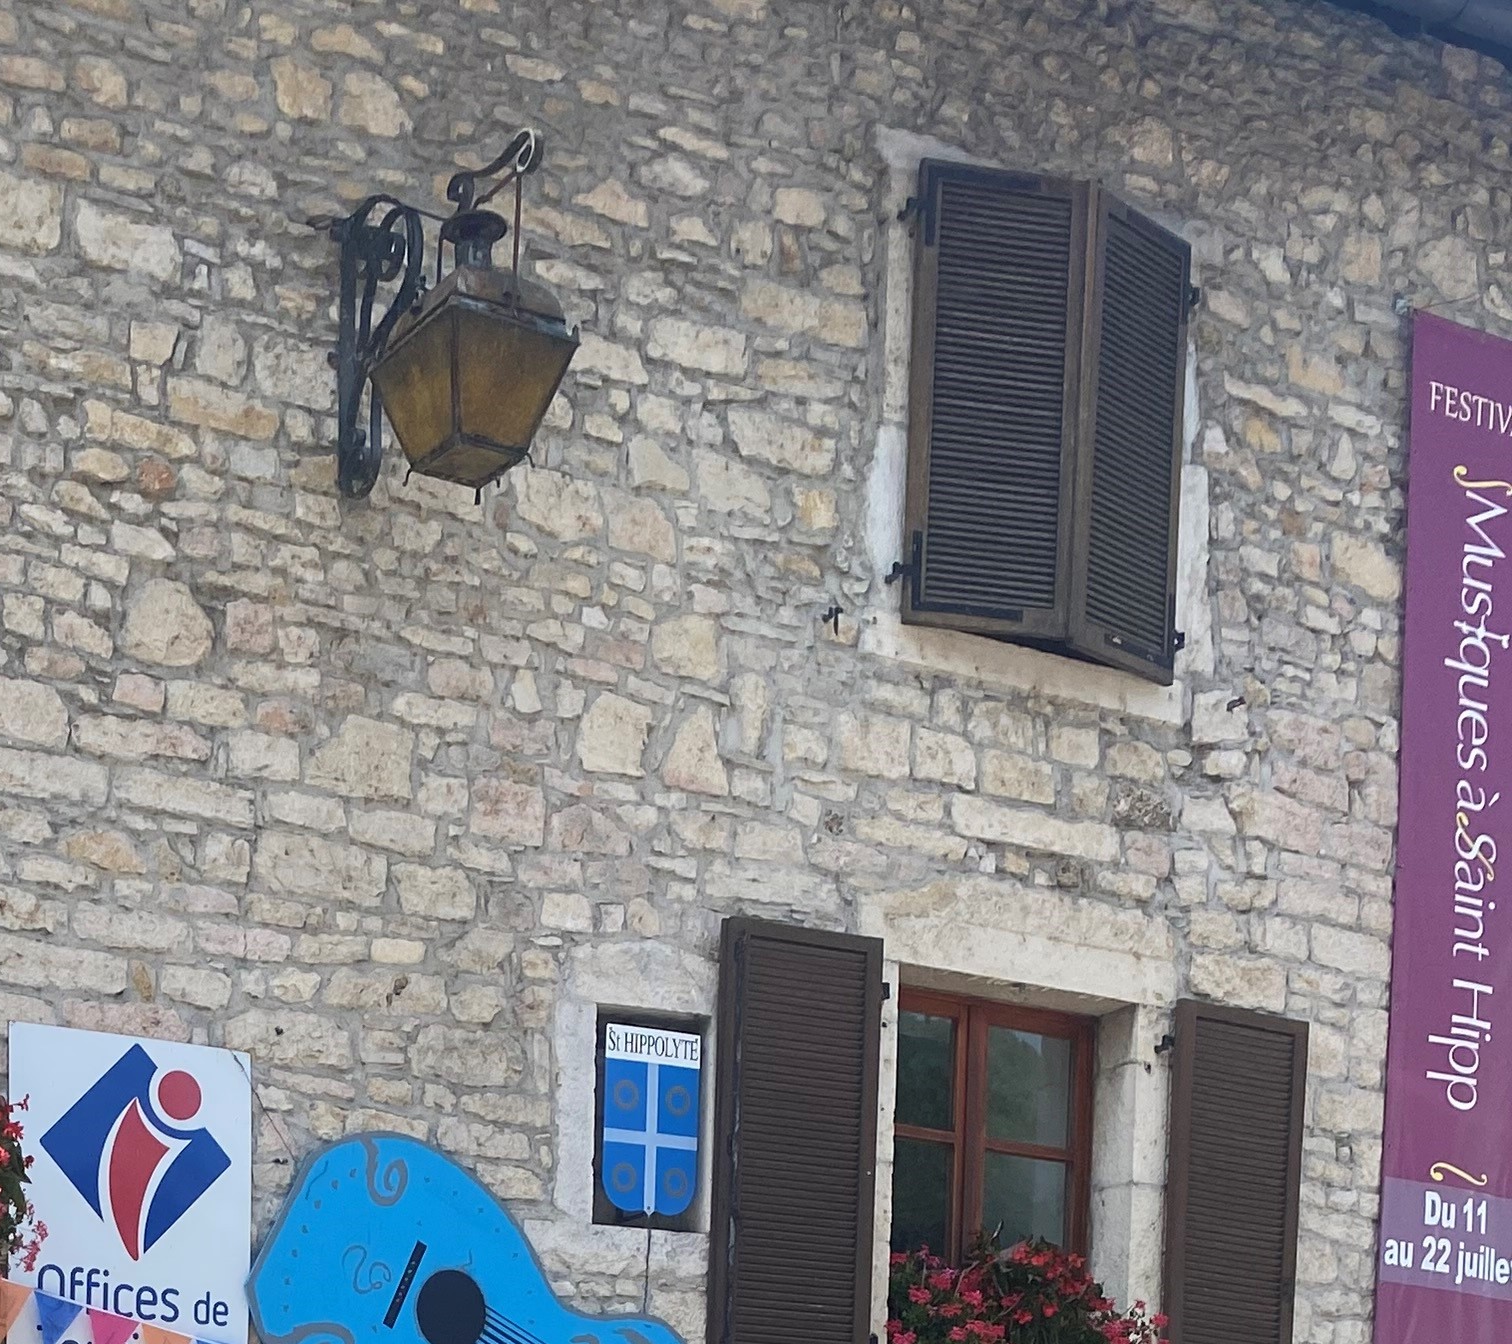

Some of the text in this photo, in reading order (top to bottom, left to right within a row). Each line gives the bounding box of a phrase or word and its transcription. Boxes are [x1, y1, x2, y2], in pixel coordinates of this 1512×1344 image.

[1429, 380, 1512, 437] FESTIV
[1426, 978, 1494, 1111] Hipp
[1424, 1190, 1488, 1235] Du 11
[1384, 1235, 1512, 1285] au 22 juille
[37, 1264, 229, 1326] Offices de
